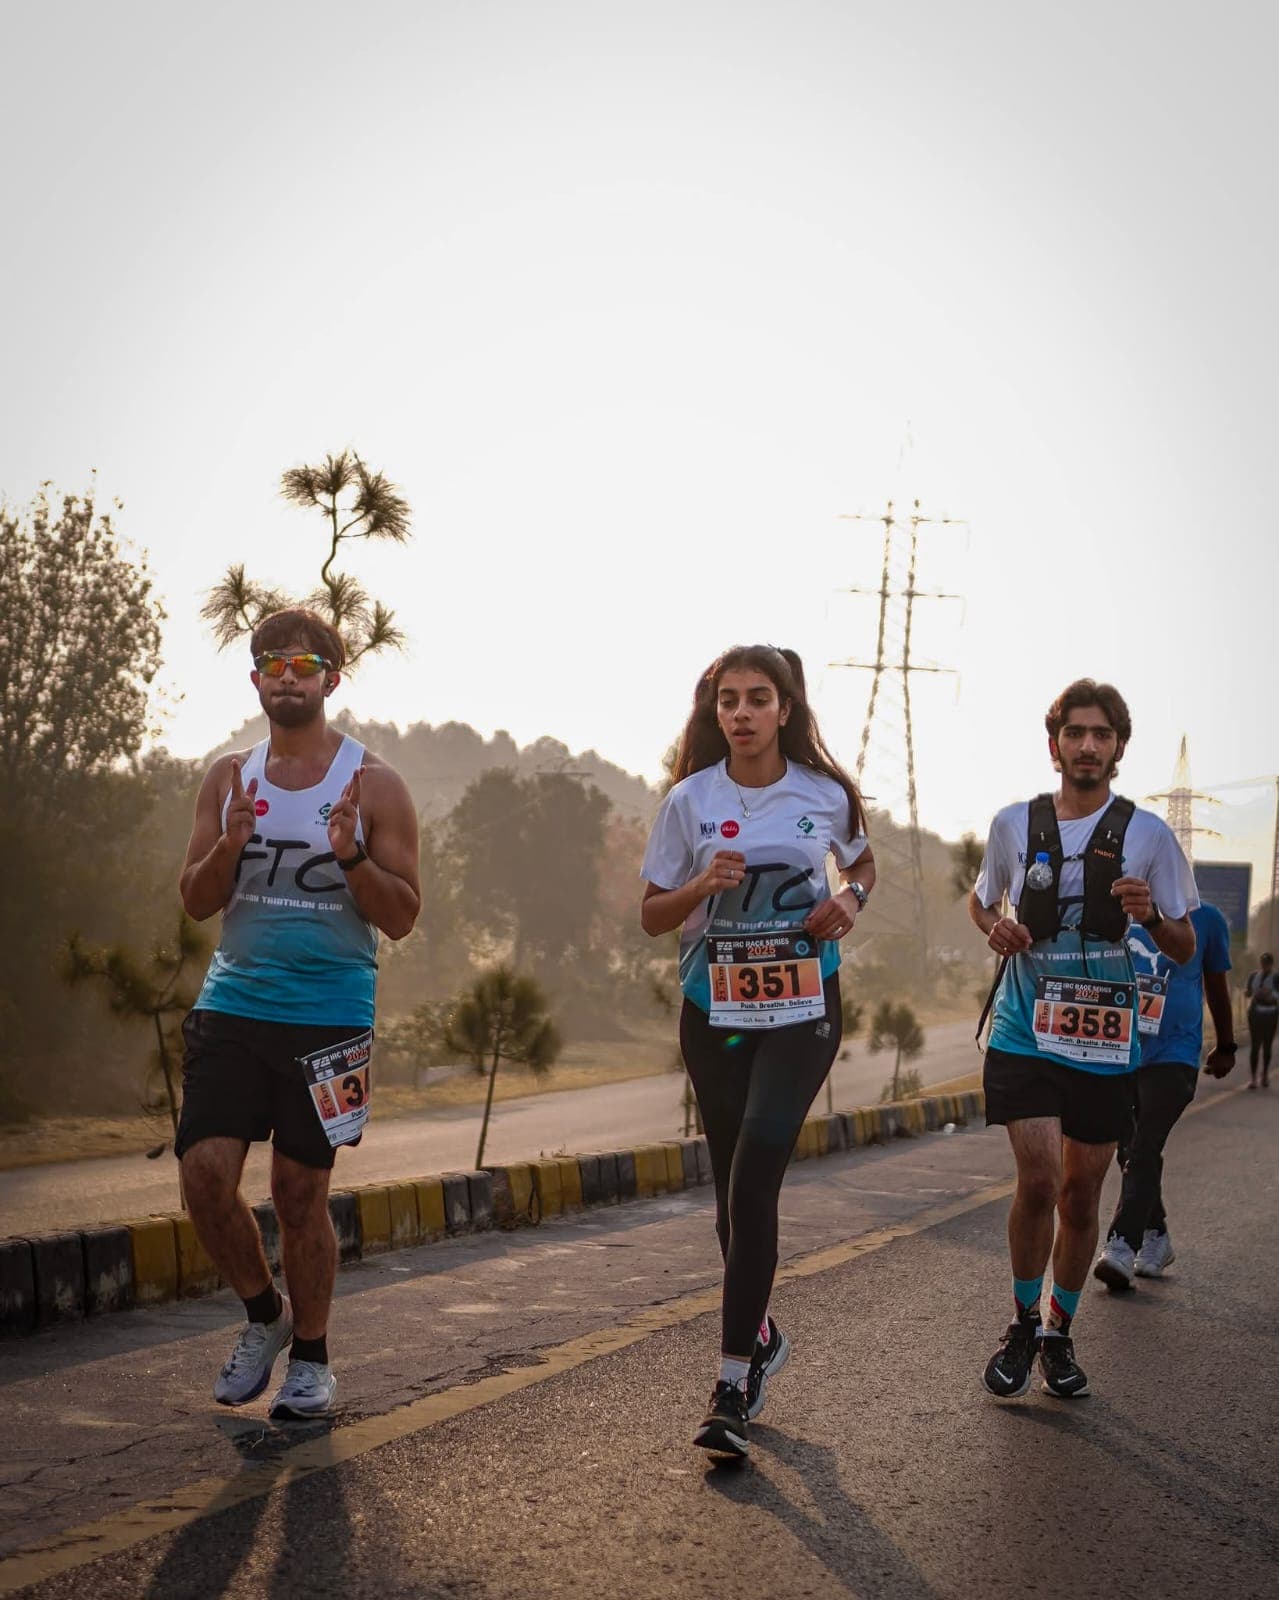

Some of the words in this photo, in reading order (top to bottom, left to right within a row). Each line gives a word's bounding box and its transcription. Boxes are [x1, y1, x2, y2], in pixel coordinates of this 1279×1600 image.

[234, 833, 346, 893] FTC
[748, 945, 778, 955] 2025
[738, 964, 800, 999] 351
[1074, 989, 1100, 999] 2025
[1140, 994, 1156, 1016] 7
[1060, 1006, 1122, 1039] 358
